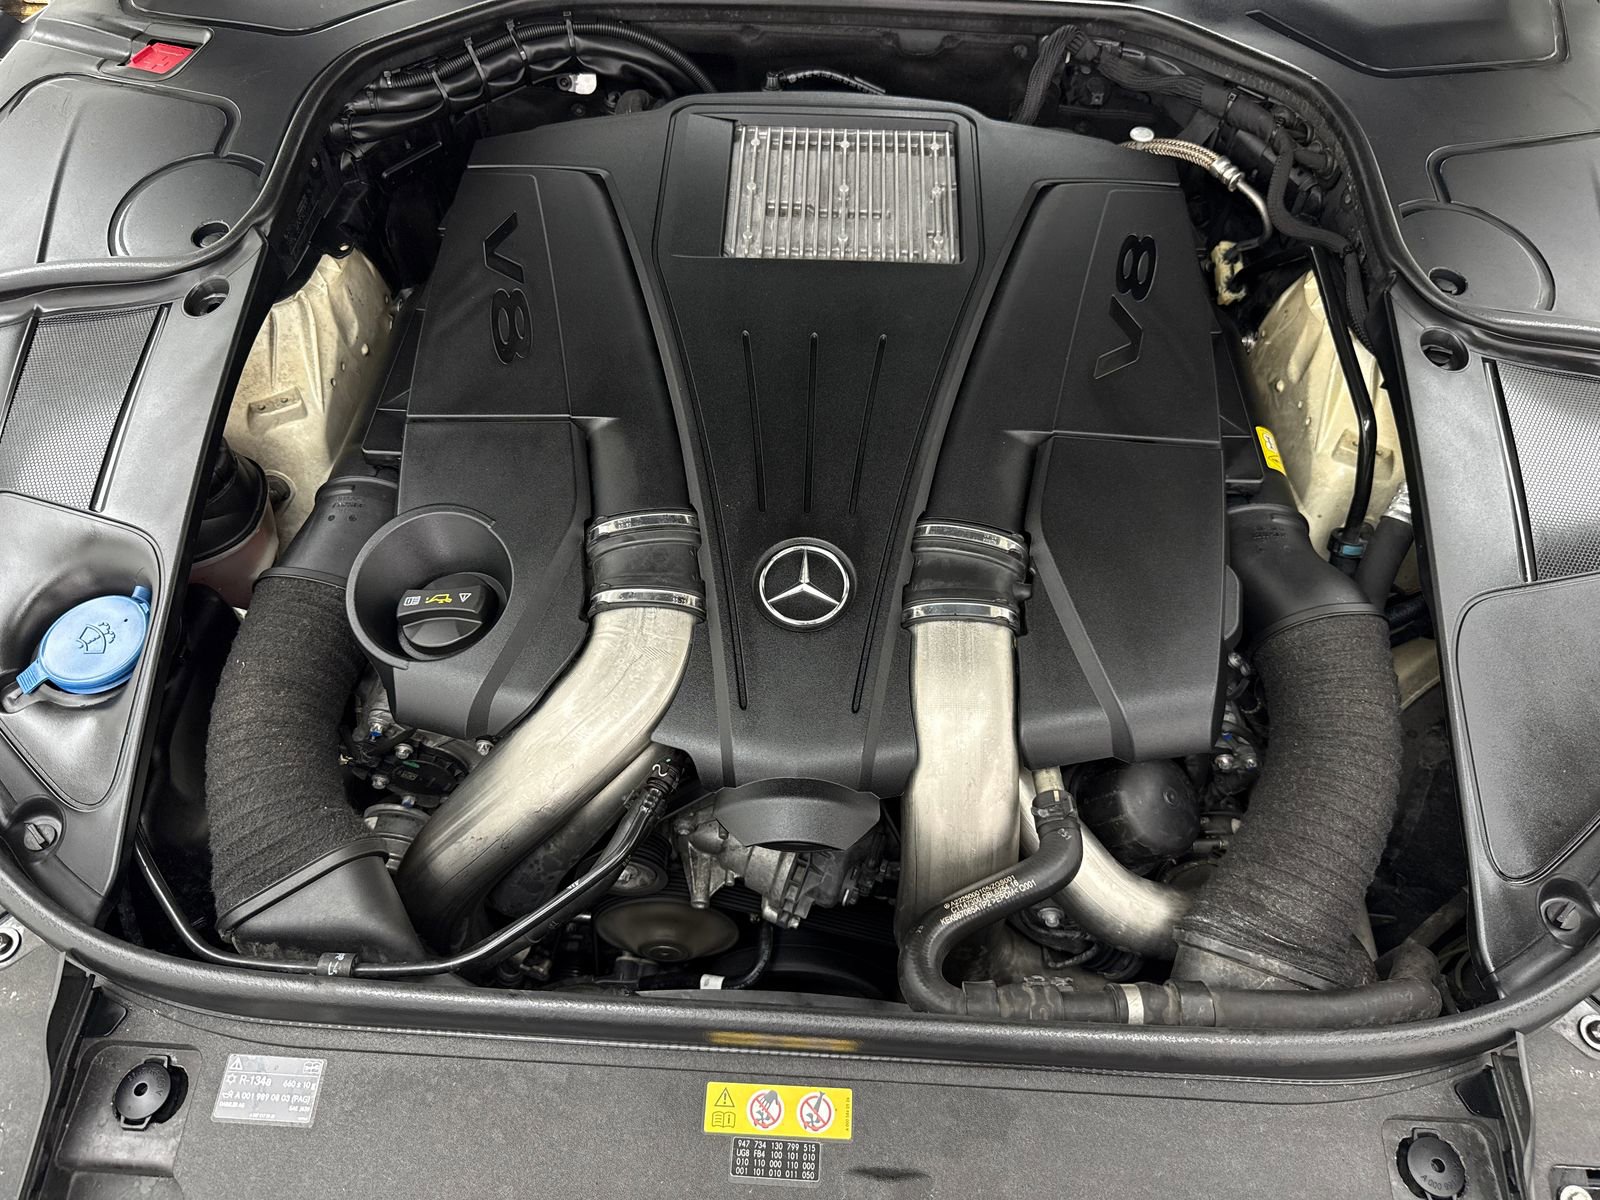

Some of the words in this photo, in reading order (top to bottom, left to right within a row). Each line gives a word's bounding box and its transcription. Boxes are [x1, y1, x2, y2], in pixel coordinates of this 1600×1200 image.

[483, 210, 534, 365] V8
[1093, 233, 1158, 379] V8
[239, 1074, 272, 1087] R-134a
[738, 1139, 750, 1148] 947
[754, 1140, 767, 1149] 734
[771, 1142, 783, 1150] 130
[787, 1143, 799, 1151] 799
[803, 1144, 816, 1152] 515
[736, 1148, 750, 1157] UG8
[753, 1150, 766, 1158] FB4
[771, 1151, 783, 1159] 100
[787, 1152, 799, 1160] 101
[803, 1153, 816, 1161] 010
[736, 1158, 749, 1166] 010
[753, 1159, 766, 1167] 110
[769, 1160, 782, 1168] 000
[787, 1161, 799, 1169] 110
[802, 1162, 815, 1170] 000
[736, 1167, 748, 1175] 001
[753, 1168, 764, 1176] 101
[769, 1169, 781, 1177] 010
[785, 1170, 797, 1178] 011
[802, 1171, 815, 1179] 050
